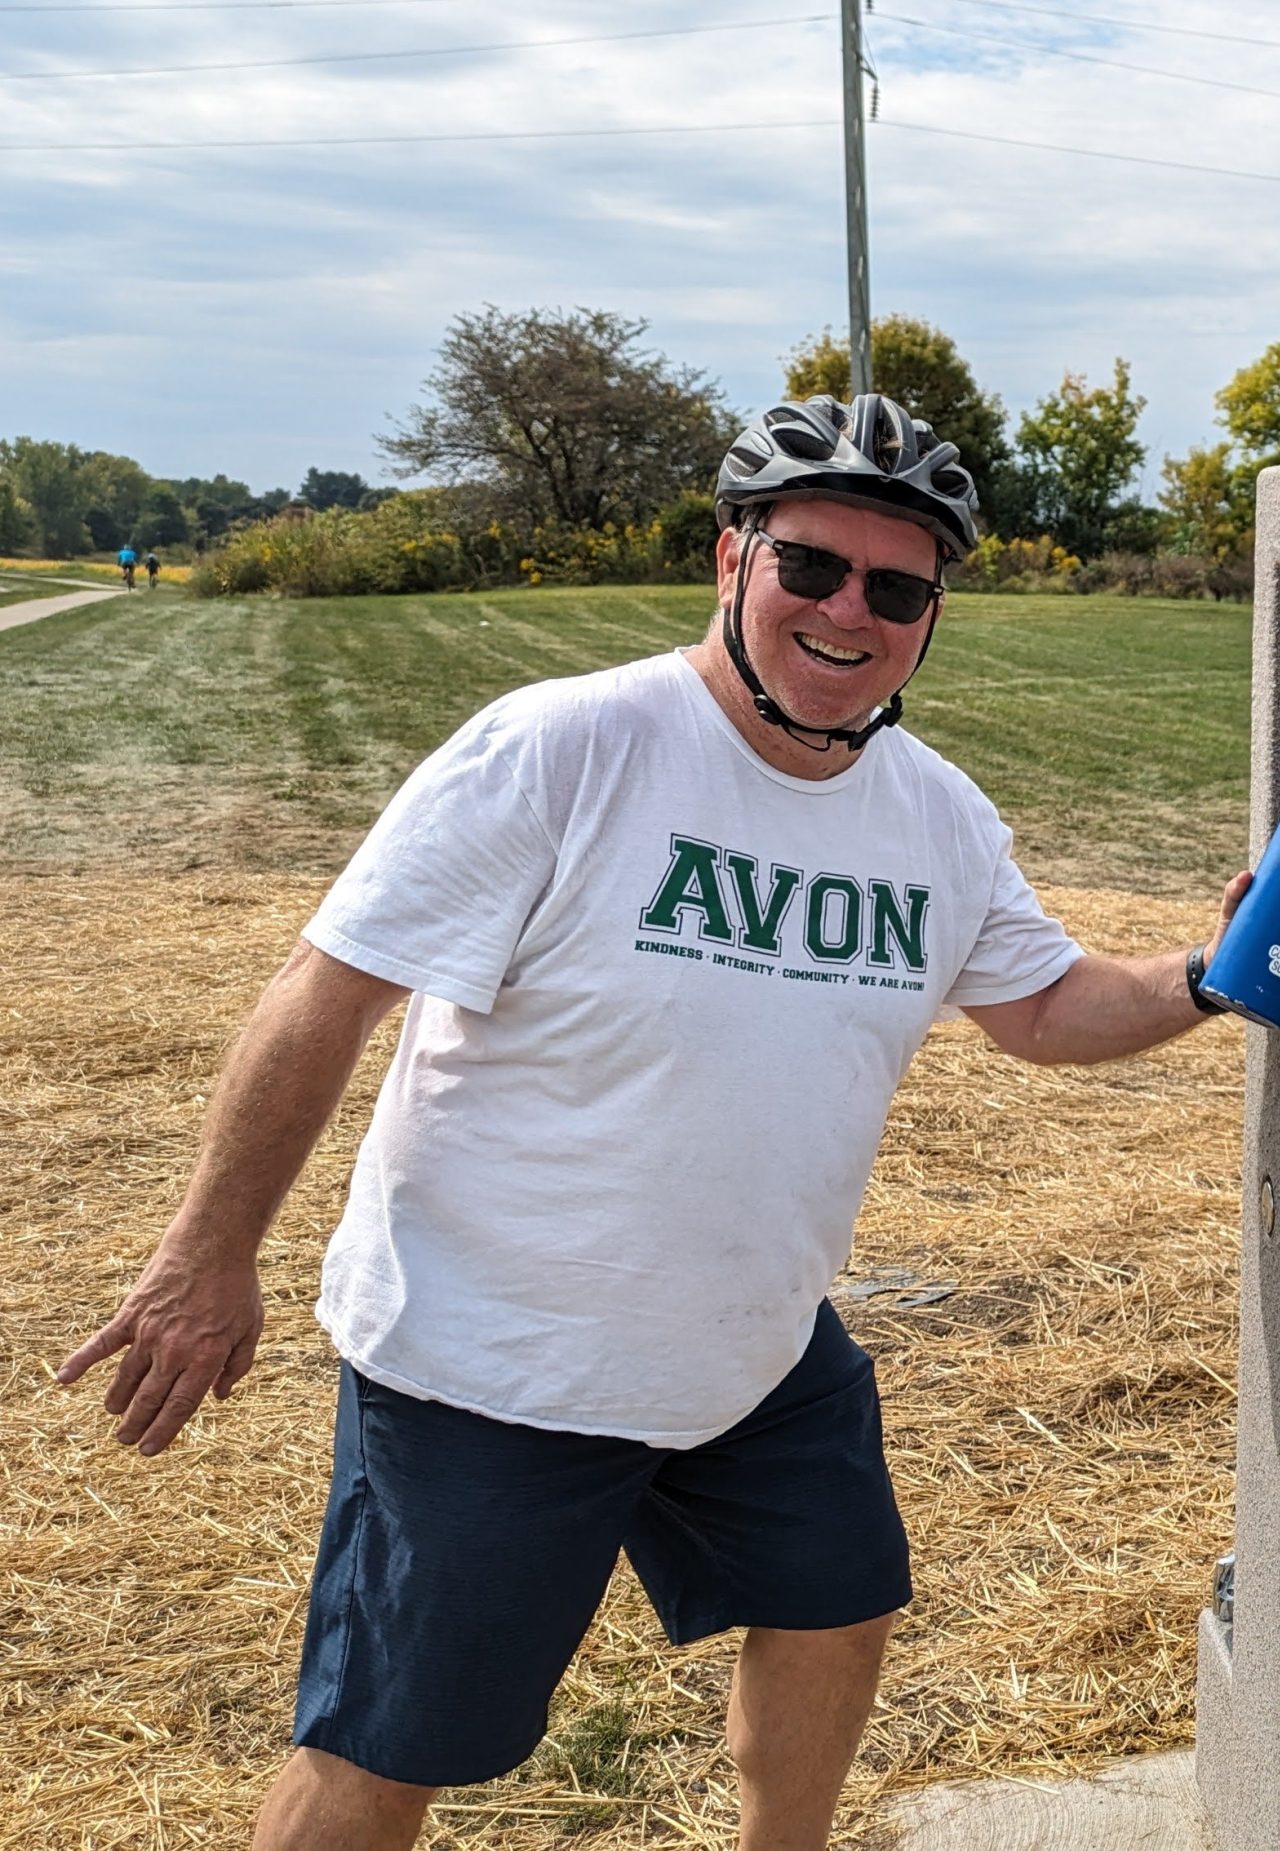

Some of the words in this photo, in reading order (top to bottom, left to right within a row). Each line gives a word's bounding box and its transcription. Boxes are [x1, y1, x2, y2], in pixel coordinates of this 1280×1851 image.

[638, 832, 931, 973] AVON
[634, 940, 703, 960] KINDNESS
[713, 953, 775, 976] INTEGRITY
[782, 968, 850, 985] COMMUNITY
[858, 975, 877, 986] WE
[878, 977, 899, 989] ARE
